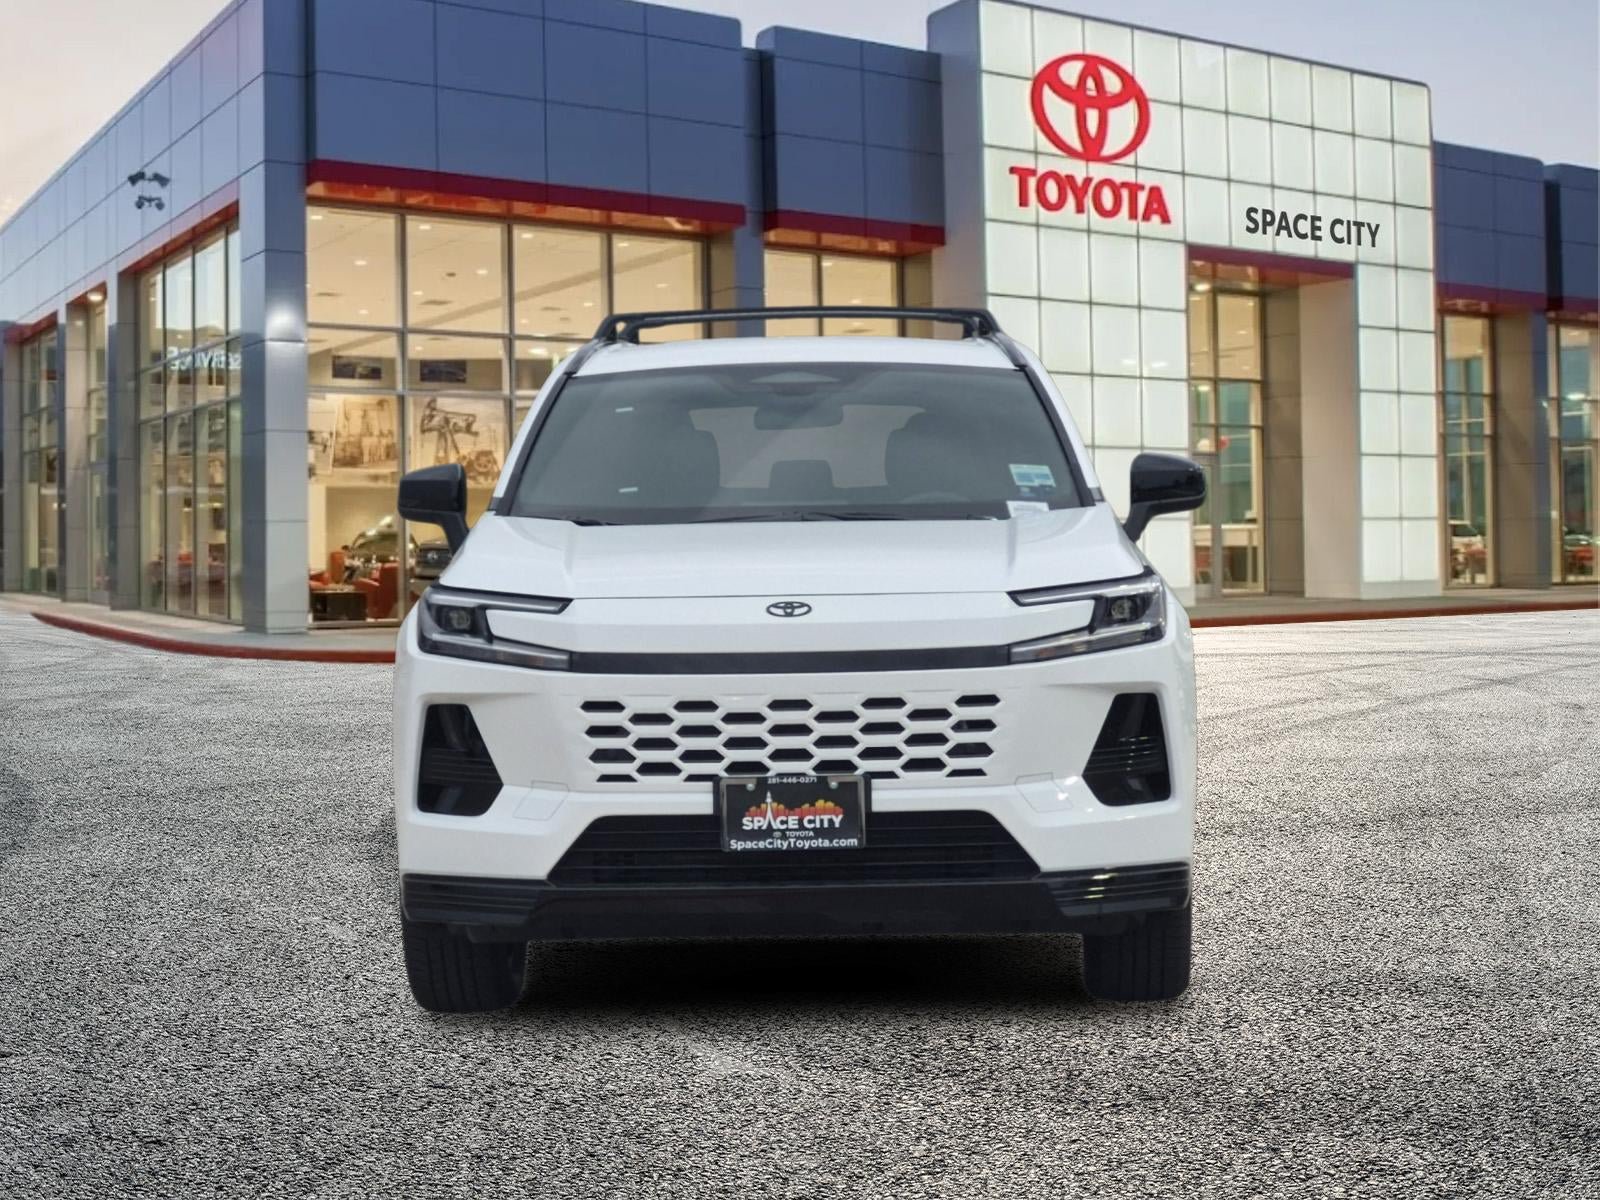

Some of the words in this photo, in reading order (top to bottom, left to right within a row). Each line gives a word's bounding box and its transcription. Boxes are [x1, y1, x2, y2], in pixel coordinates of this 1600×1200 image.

[1009, 166, 1171, 225] TOYOTA
[1245, 206, 1323, 242] SPACE
[1329, 218, 1381, 249] CITY
[742, 809, 799, 830] SPACE
[803, 815, 844, 828] CITY
[730, 838, 858, 850] SpaceCityToyota.com
